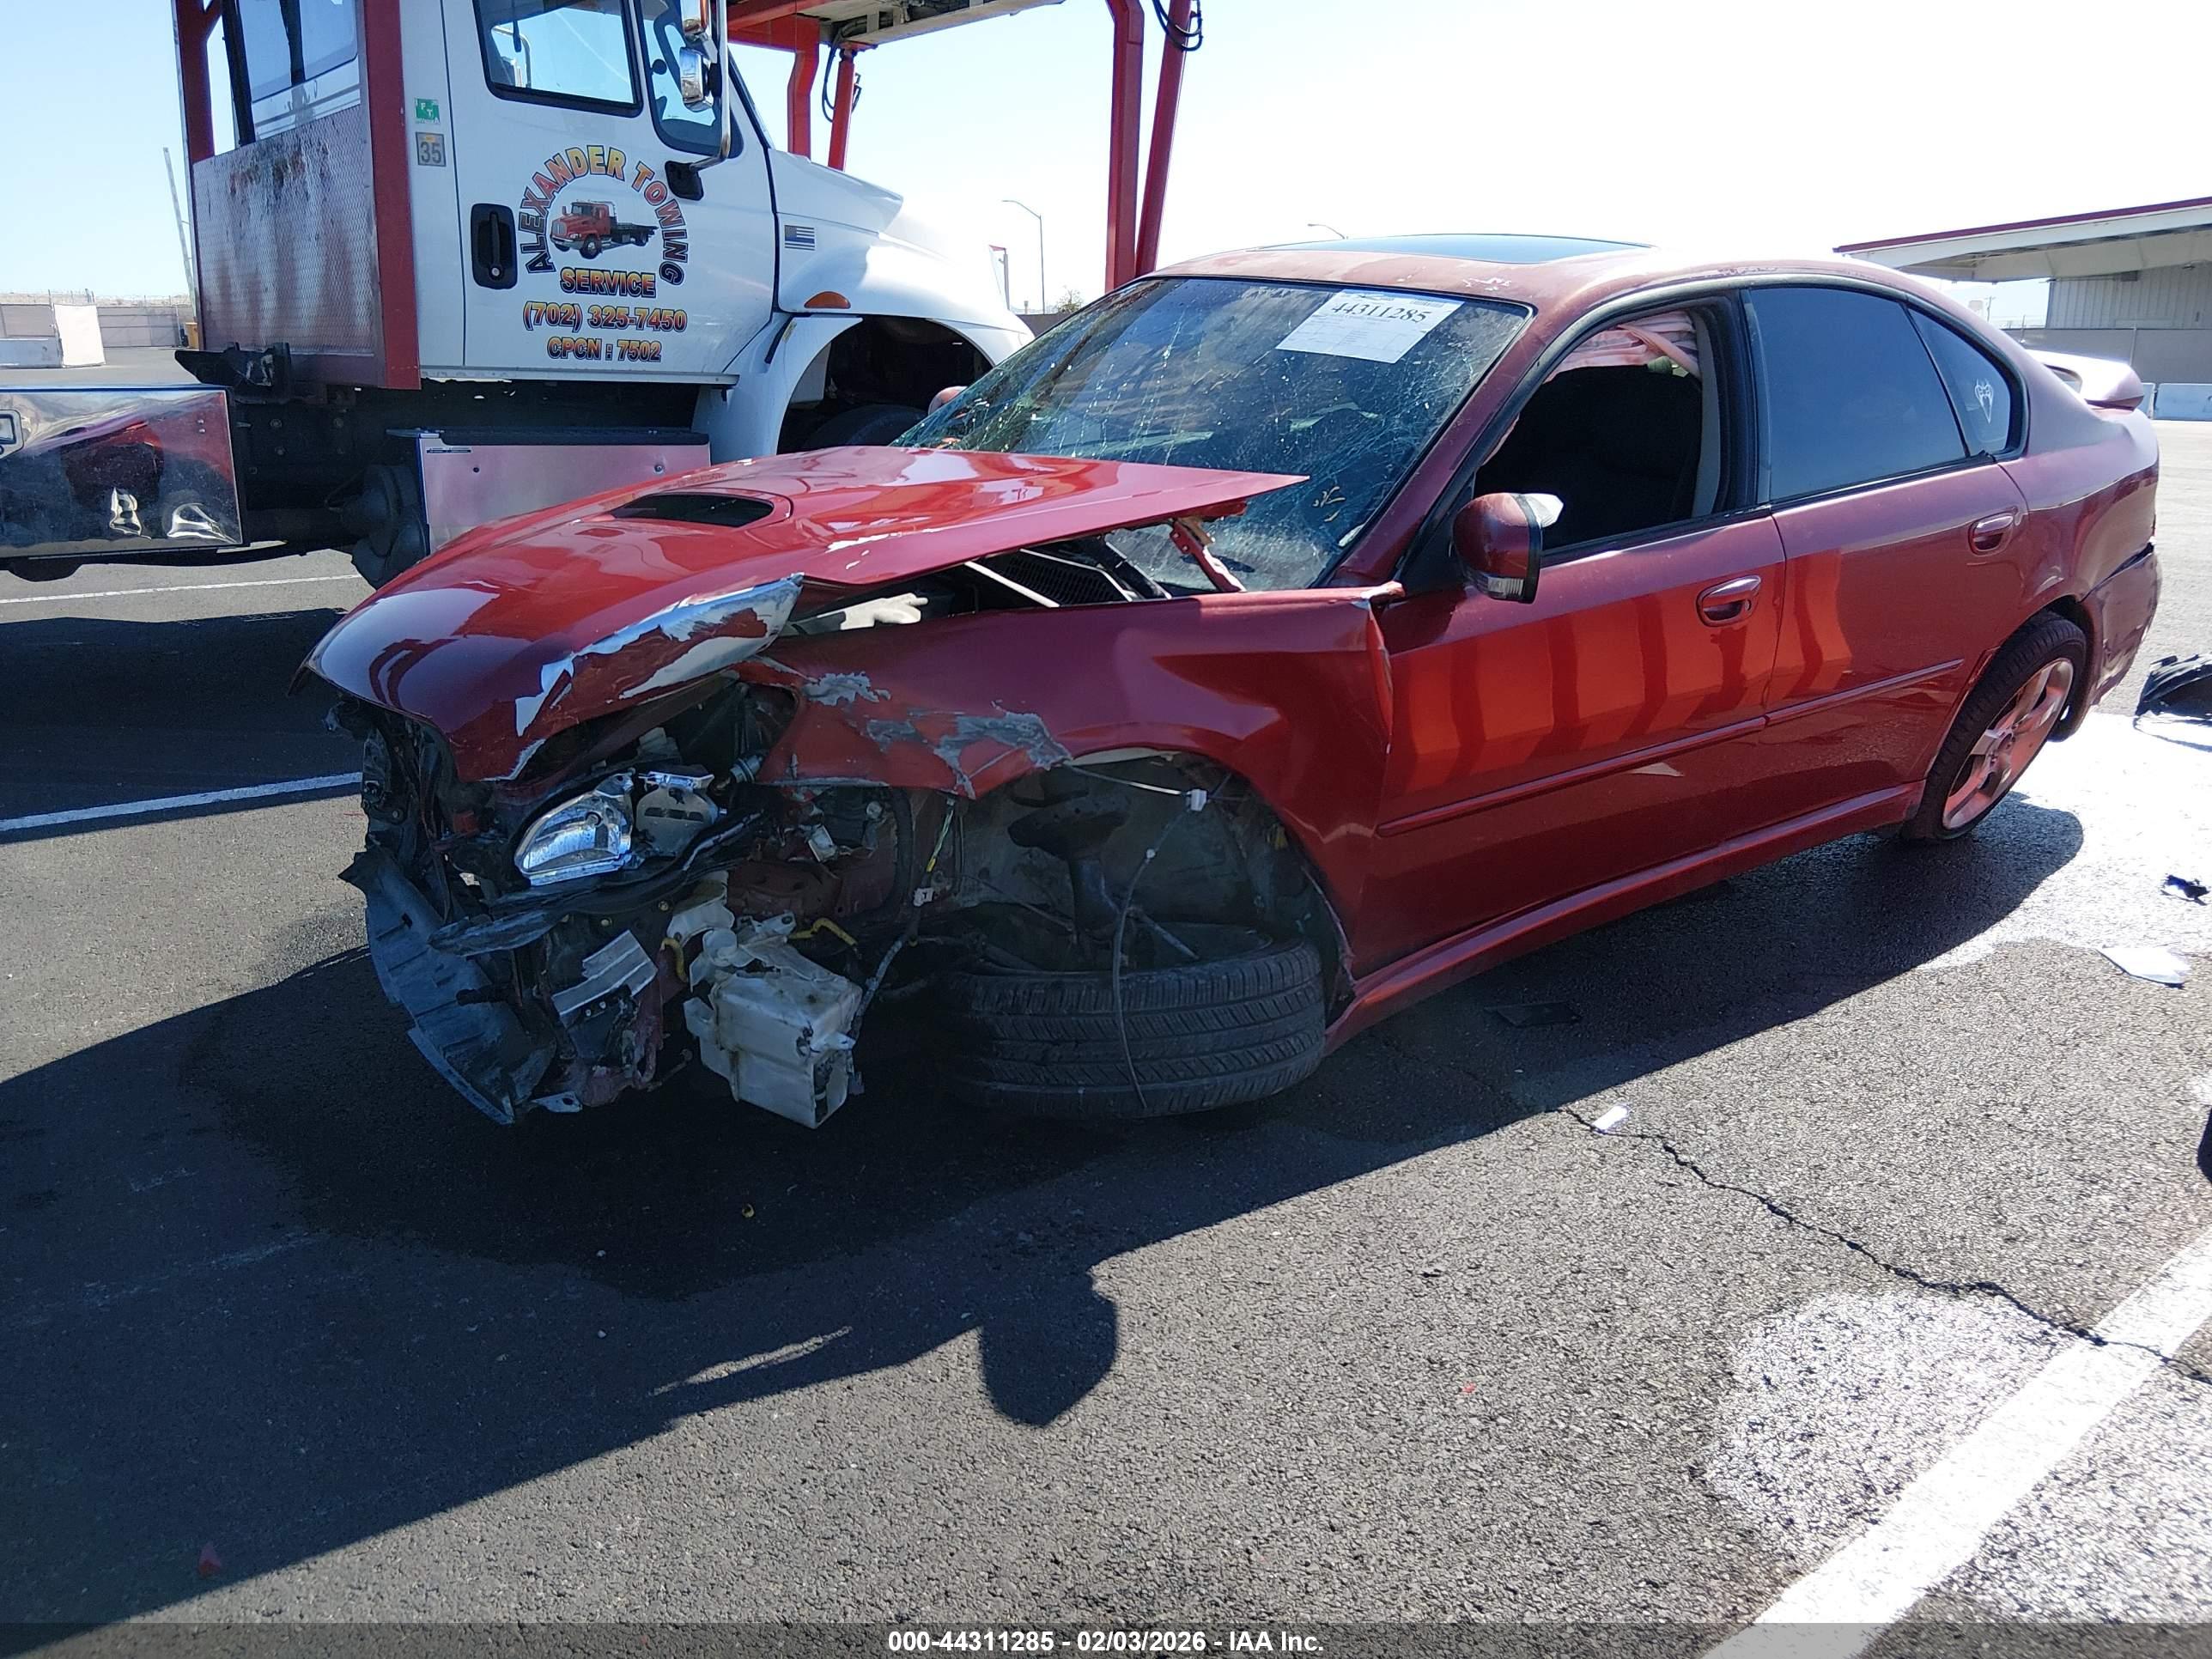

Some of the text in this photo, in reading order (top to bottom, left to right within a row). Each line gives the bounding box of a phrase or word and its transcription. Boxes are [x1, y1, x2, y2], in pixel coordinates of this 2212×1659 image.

[420, 142, 442, 163] 35
[519, 145, 689, 285] ALEXANDER TOWING
[560, 267, 657, 298] SERVICE
[523, 301, 688, 332] (702) 325-7450
[1331, 302, 1432, 323] 44311285
[547, 337, 603, 361] CPCN
[617, 340, 663, 362] 7502
